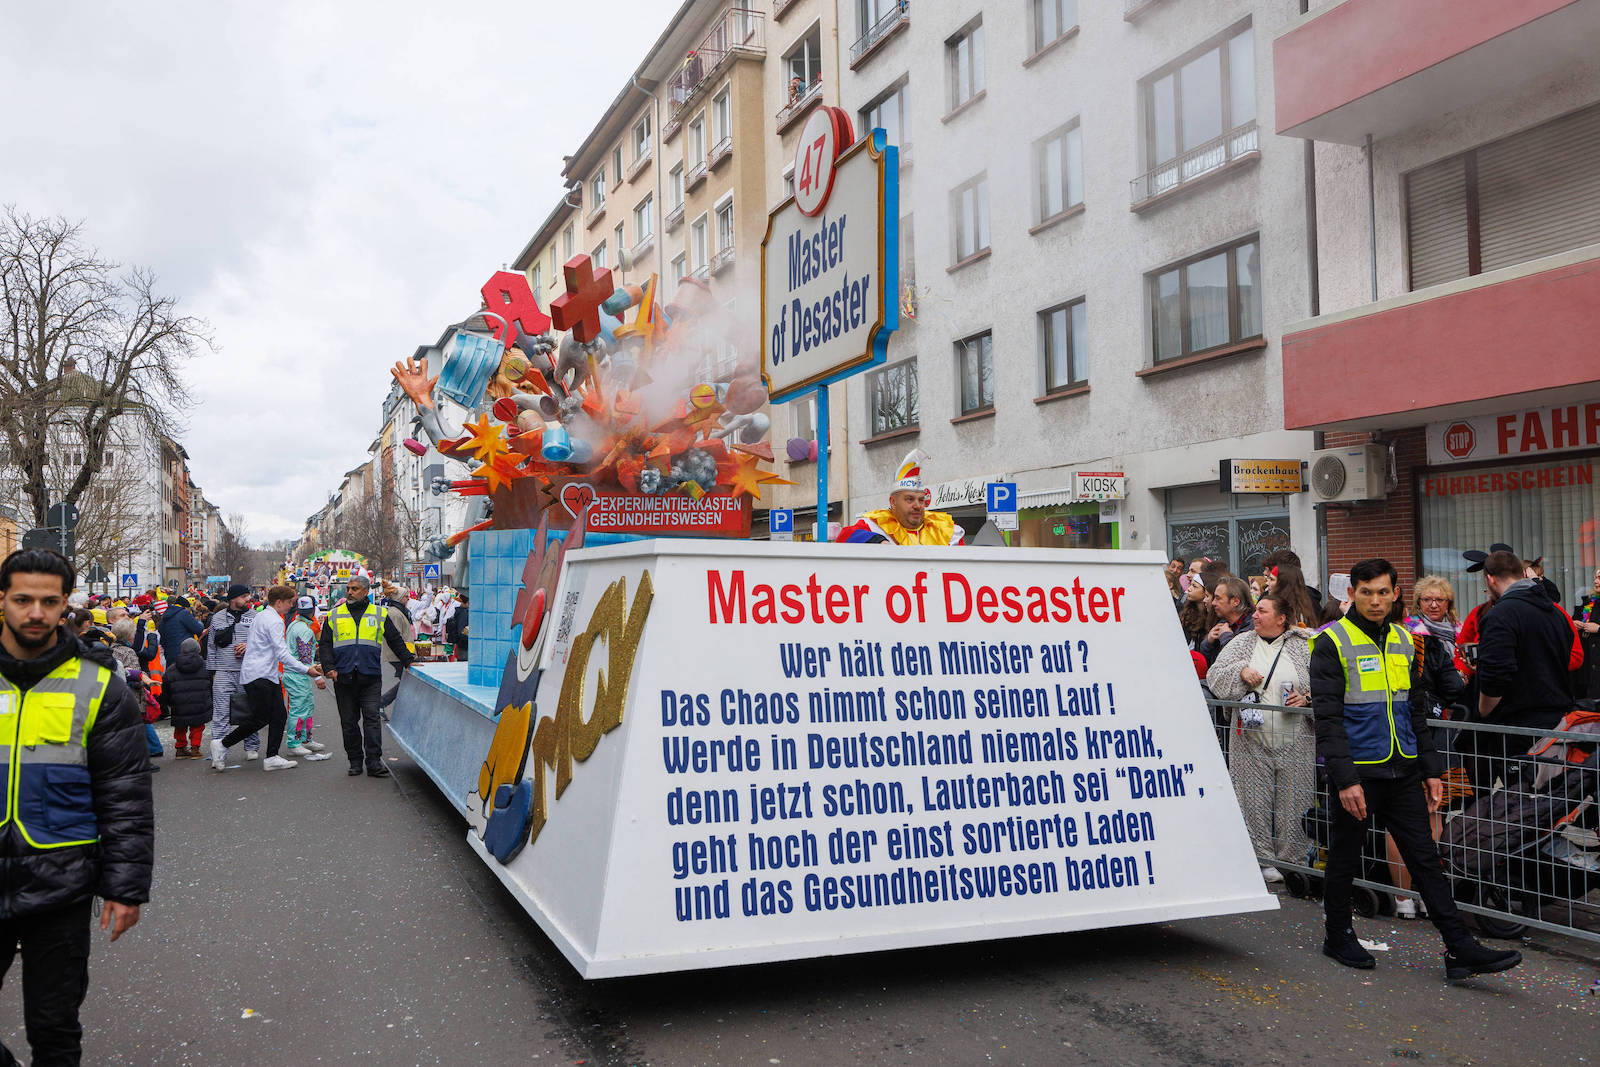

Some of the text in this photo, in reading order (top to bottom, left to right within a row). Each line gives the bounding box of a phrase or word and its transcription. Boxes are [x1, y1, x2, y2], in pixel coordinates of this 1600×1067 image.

[800, 133, 826, 196] 47
[788, 214, 846, 292] Master
[772, 274, 869, 366] of Desaster
[1450, 432, 1469, 450] STOP
[1083, 478, 1117, 492] KIOSK
[1234, 465, 1299, 474] Brockenhaus
[1425, 464, 1593, 496] FÜHRERSCHEIN
[600, 496, 742, 512] EXPERIMENTIERKASTEN
[961, 480, 986, 503] Kiosk
[994, 487, 1009, 509] P
[590, 512, 722, 526] GESUNDHEITSWESEN
[775, 512, 787, 530] P
[707, 569, 1126, 625] Master of Desaster
[779, 639, 1089, 679] Wer hält den Minister auf ?
[661, 682, 1116, 727] Das Chaos nimmt schon seinen Lauf !
[662, 724, 1163, 774] Werde in Deutschland niemals krank,
[667, 786, 739, 826] denn
[750, 780, 813, 825] jetzt
[822, 778, 913, 817] schon,
[921, 769, 1066, 812] Lauterbach
[1074, 767, 1109, 803] sei
[672, 809, 1155, 880] geht hoch der einst sortierte Laden
[675, 851, 1155, 922] und das Gesundheitswesen baden !
